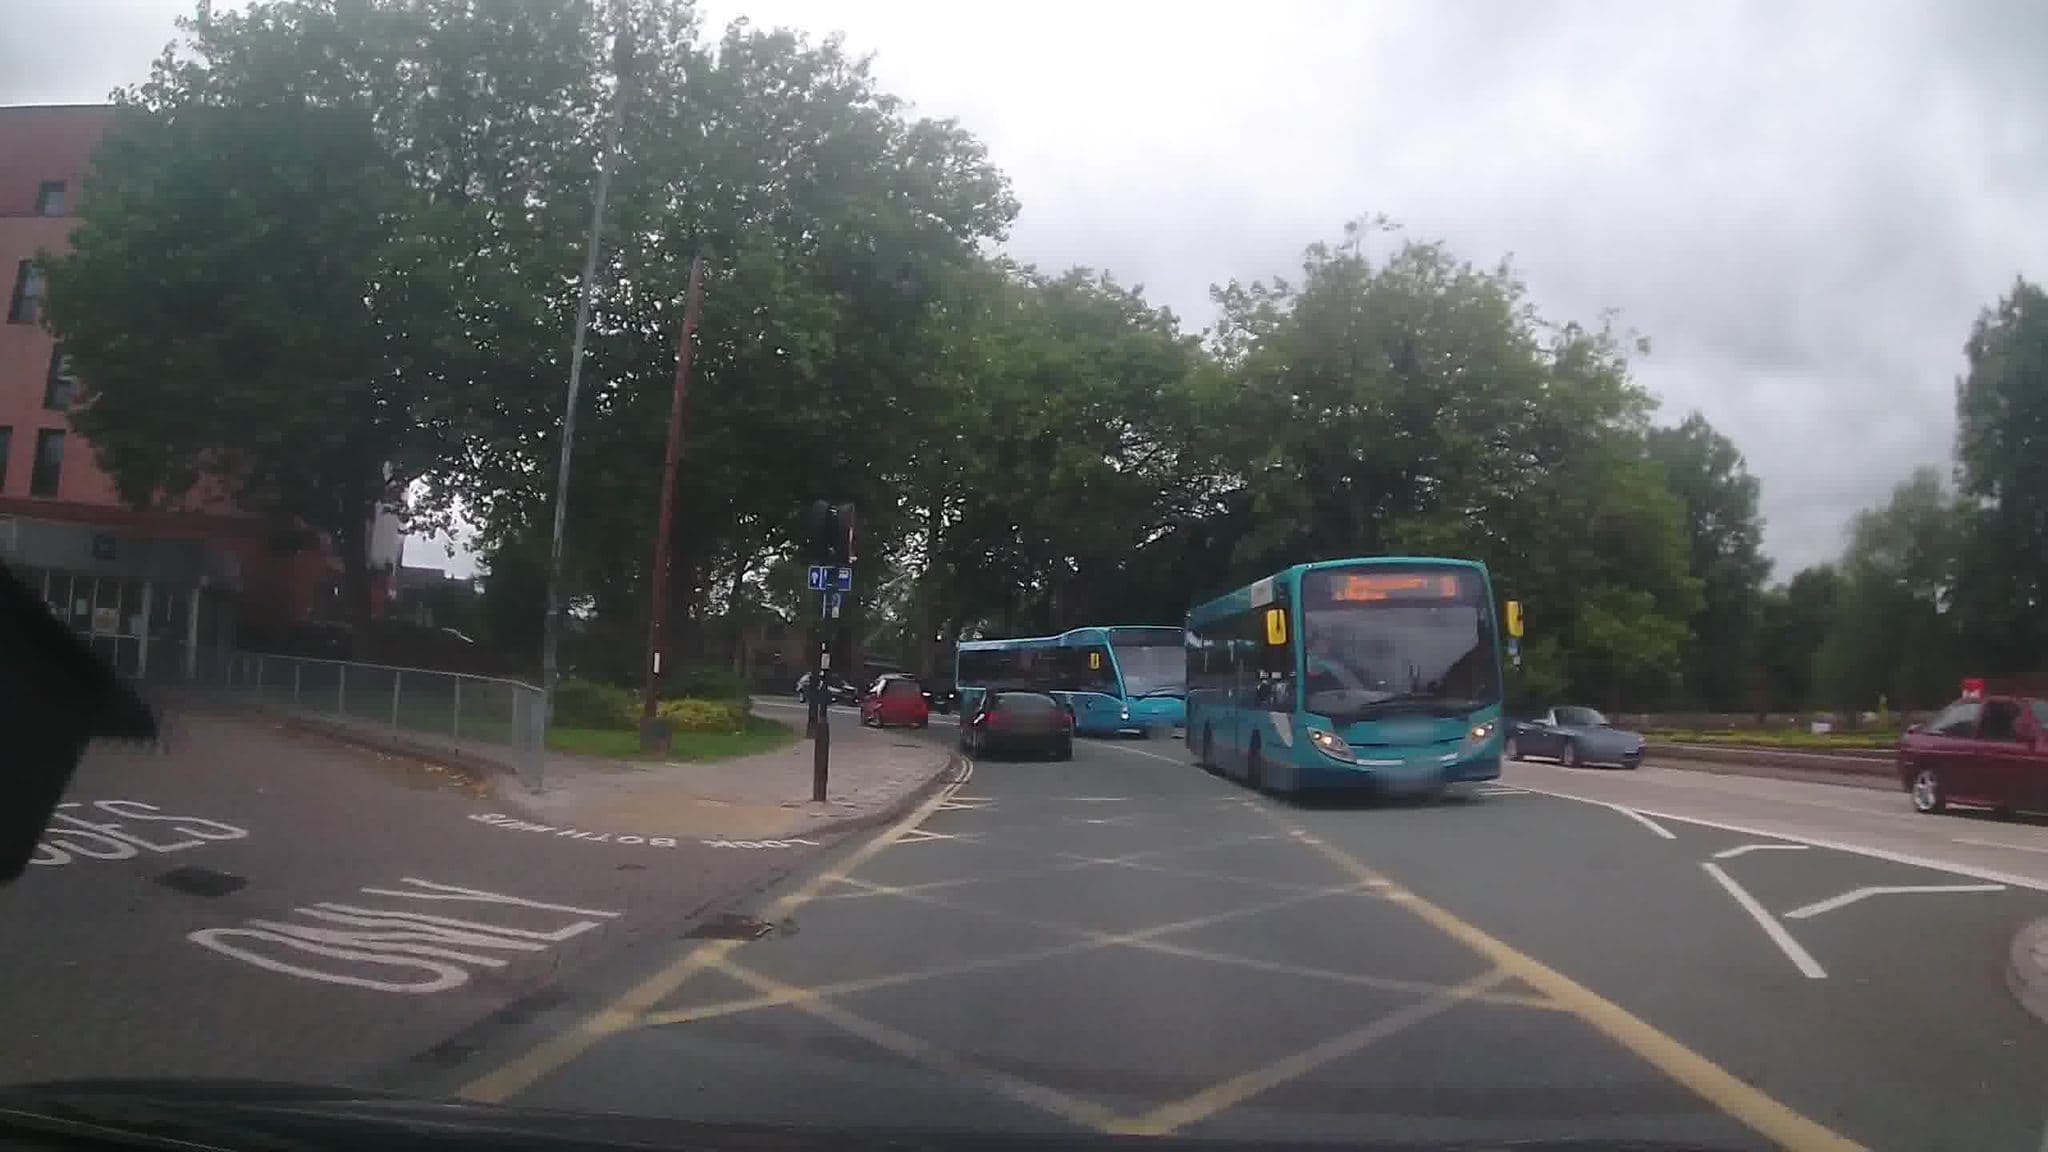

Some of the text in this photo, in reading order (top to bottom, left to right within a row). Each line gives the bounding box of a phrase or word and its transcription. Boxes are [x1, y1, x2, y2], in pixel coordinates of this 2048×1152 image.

[556, 828, 676, 847] BOTH
[701, 838, 821, 849] LOOK
[187, 877, 622, 992] ONLY
